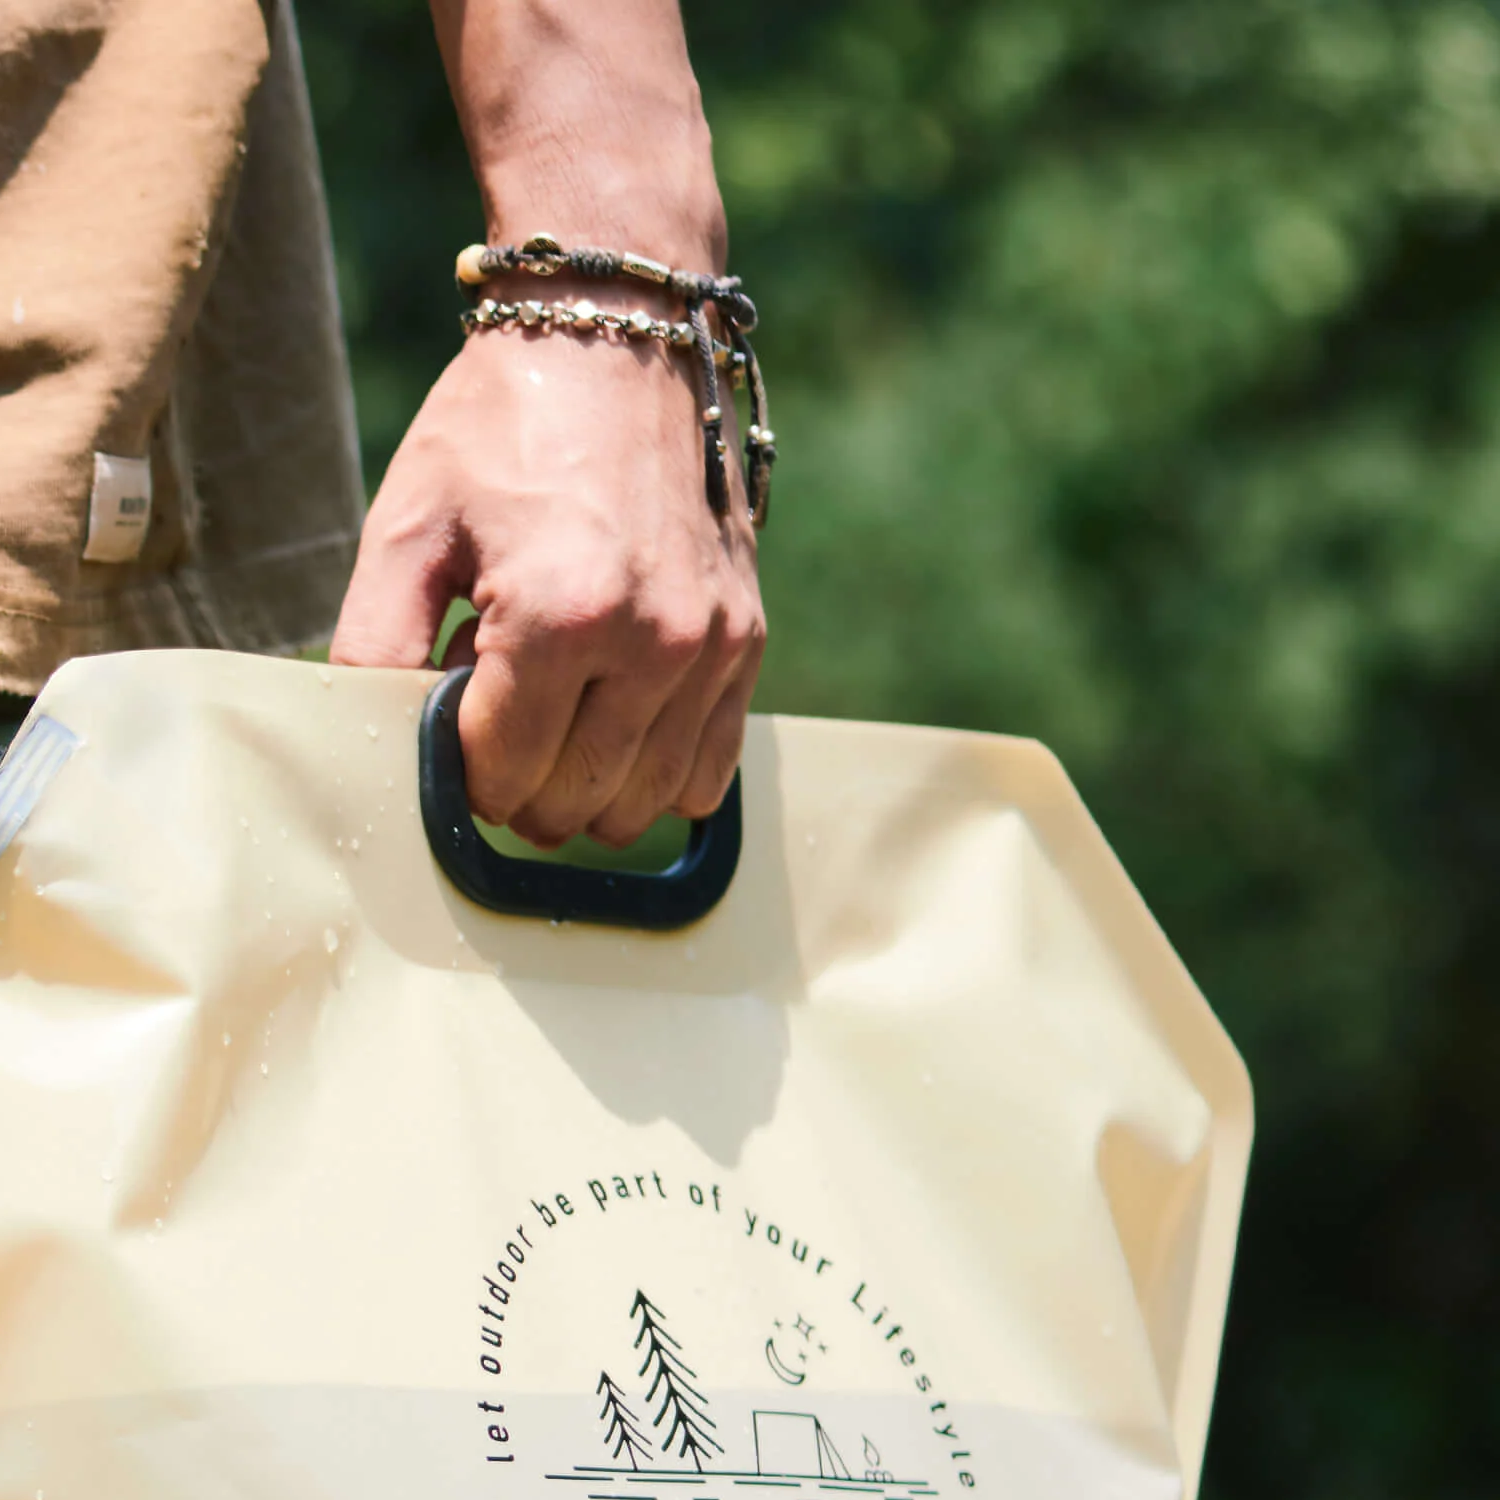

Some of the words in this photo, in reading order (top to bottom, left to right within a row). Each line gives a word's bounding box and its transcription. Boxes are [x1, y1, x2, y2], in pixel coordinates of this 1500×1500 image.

[529, 1192, 575, 1229] be
[586, 1170, 668, 1213] part
[688, 1183, 722, 1214] of
[744, 1207, 833, 1276] your
[477, 1223, 534, 1376] outdoor
[850, 1281, 976, 1489] Lifestyle
[476, 1400, 515, 1463] let
